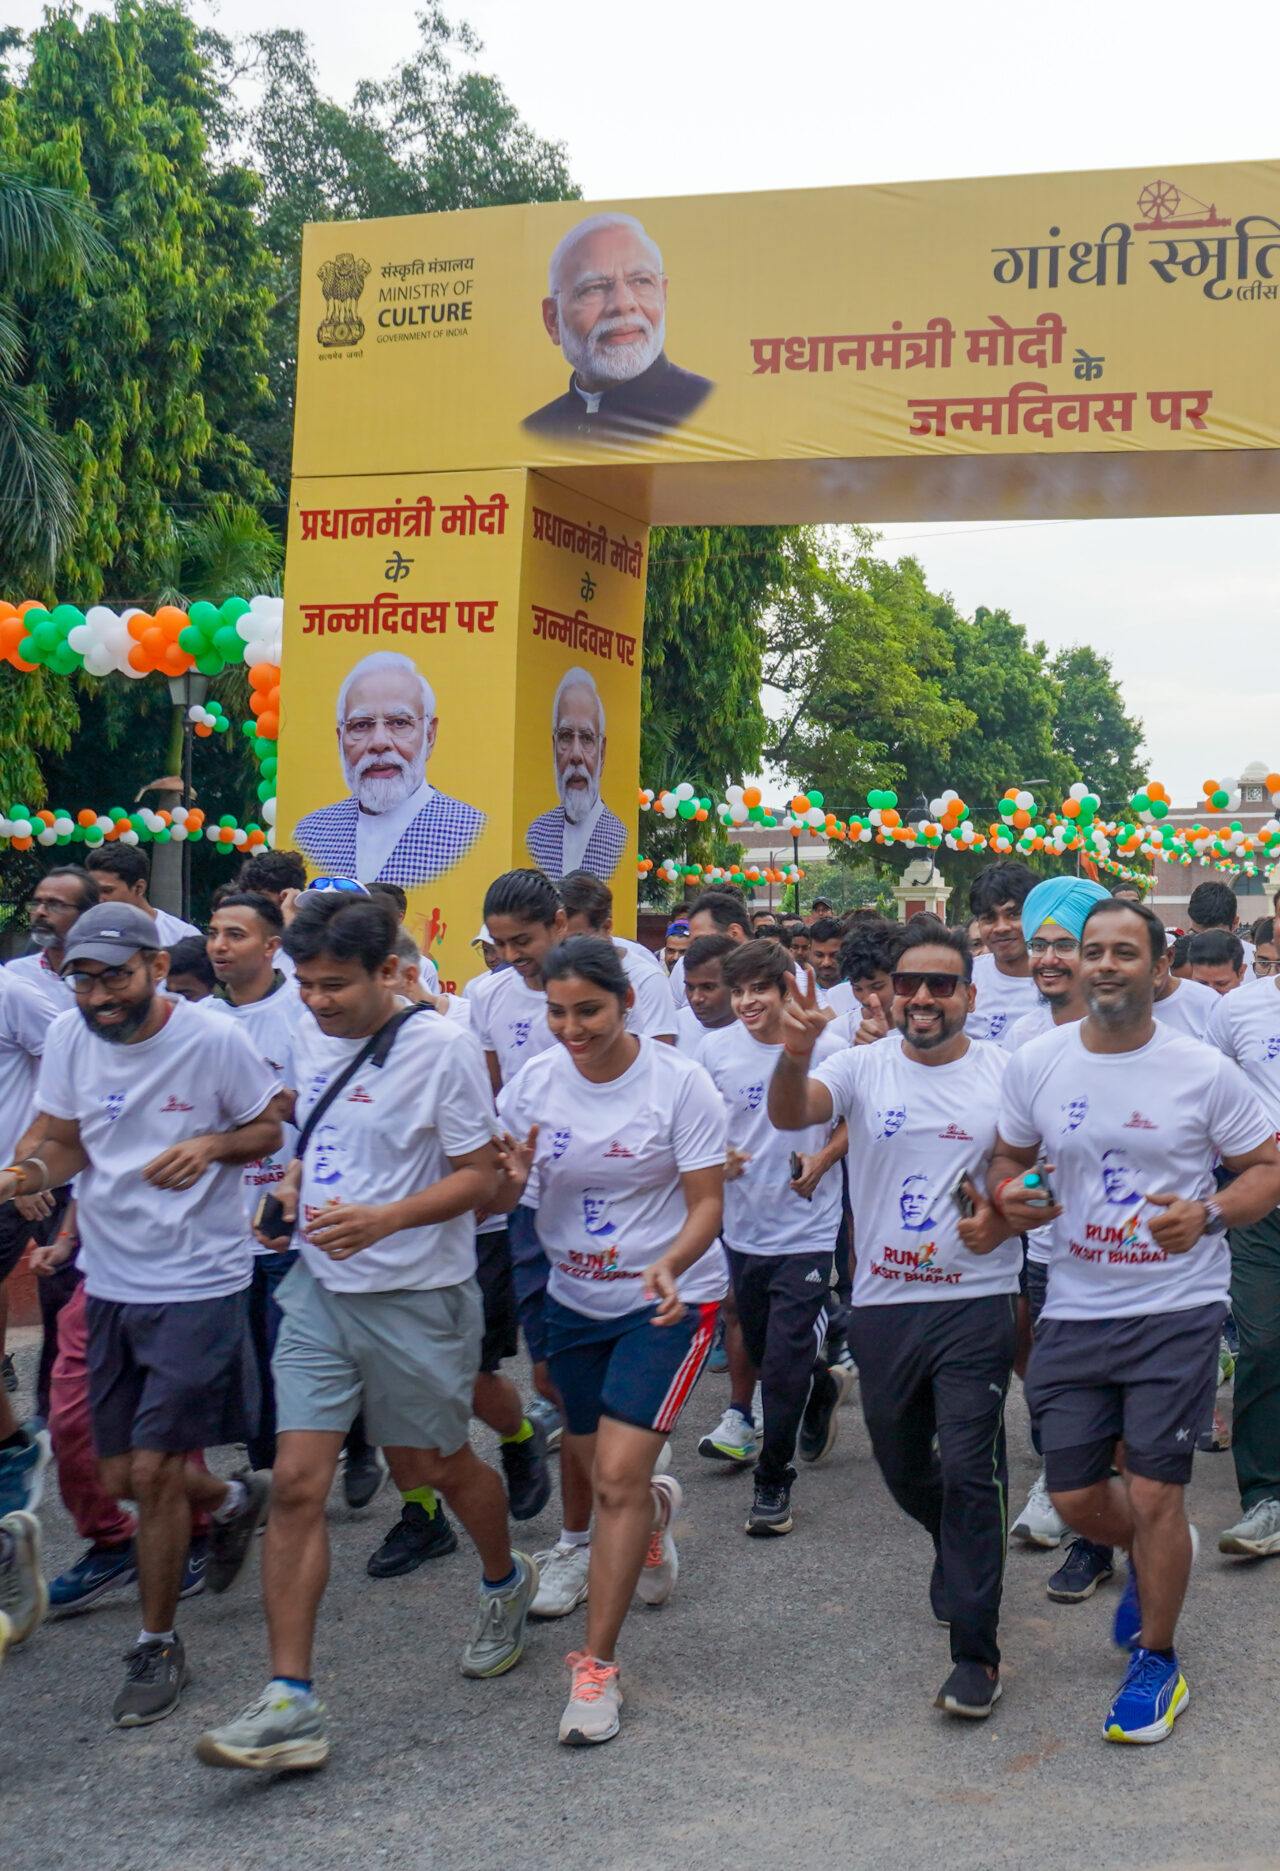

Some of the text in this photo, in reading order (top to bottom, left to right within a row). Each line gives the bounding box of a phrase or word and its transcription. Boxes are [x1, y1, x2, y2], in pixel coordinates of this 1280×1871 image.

[381, 257, 474, 282] संस्कृति मंत्रालय
[991, 222, 1134, 290] गांधी
[379, 279, 474, 302] MINISTRY OF
[378, 301, 473, 328] CULTURE
[376, 327, 468, 344] GOVERNMENT OF INDIA
[750, 313, 1067, 375] प्रधानमंत्री मोदी
[1072, 349, 1105, 381] के
[907, 382, 1213, 438] जन्मदिवस पर
[300, 493, 509, 541] प्रधानमंत्री मोदी
[532, 506, 644, 579] प्रधानमंत्री मोदी
[384, 551, 414, 582] के
[580, 572, 597, 602] के
[300, 592, 498, 636] जन्मदिवस पर
[532, 605, 637, 667] जन्मदिवस पर
[884, 1246, 921, 1266] RUN
